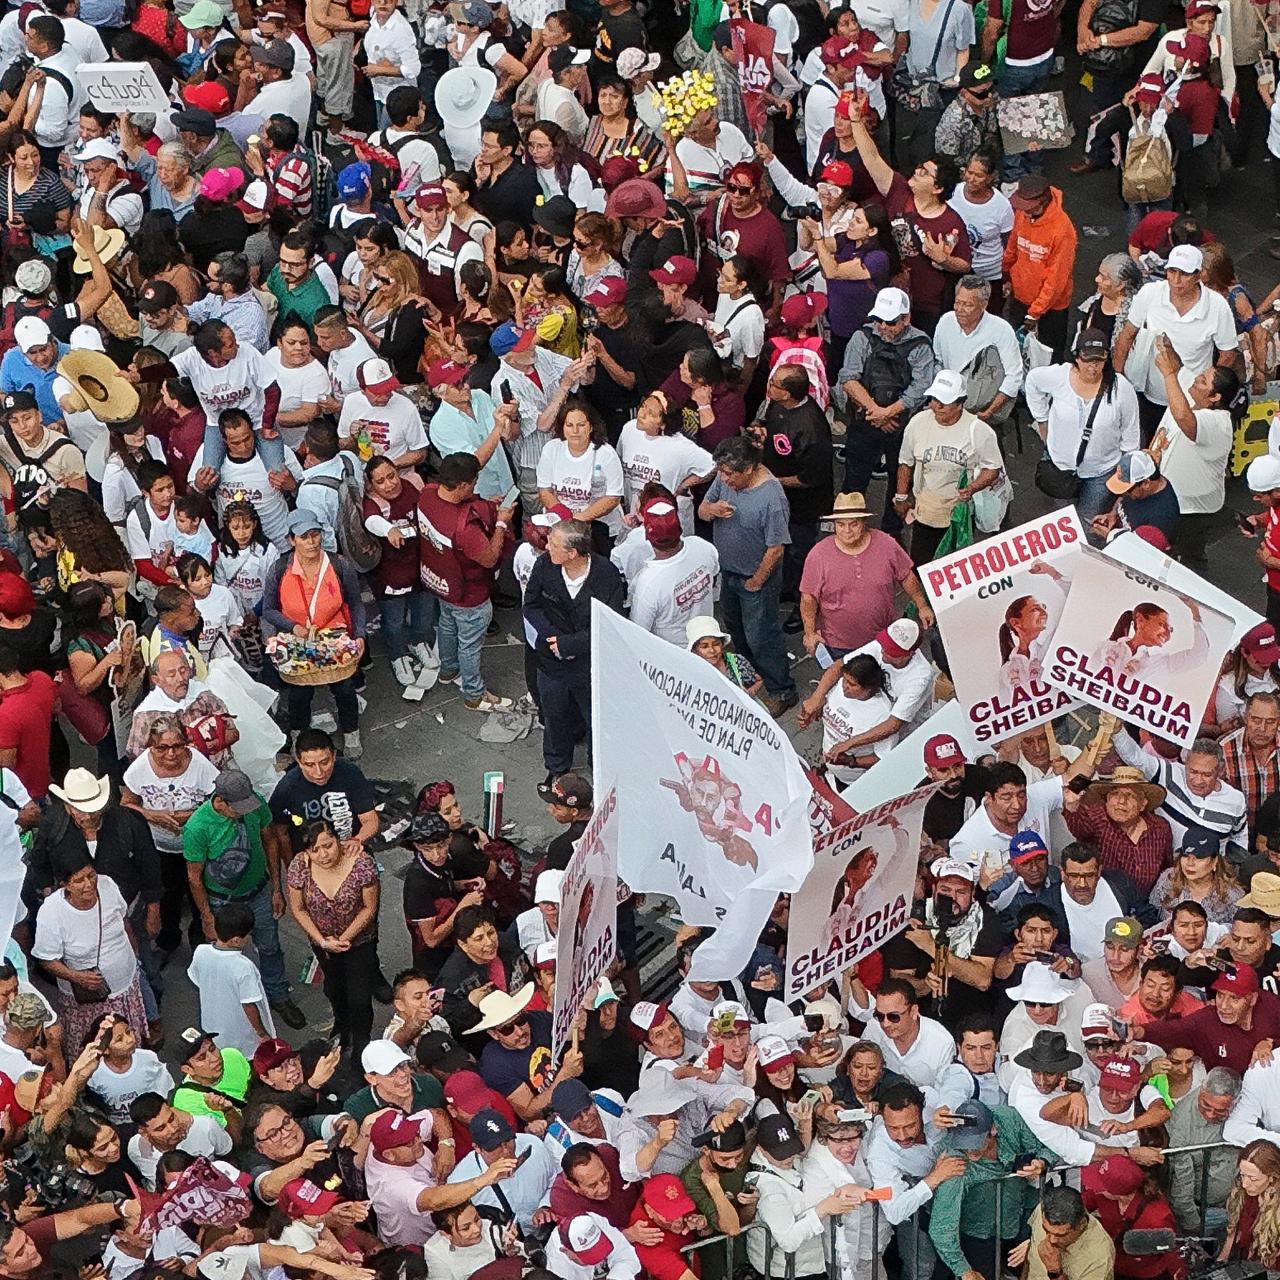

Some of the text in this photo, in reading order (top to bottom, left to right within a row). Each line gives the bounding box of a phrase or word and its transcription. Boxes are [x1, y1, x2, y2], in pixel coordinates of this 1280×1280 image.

[928, 516, 1079, 598] PETROLEROS
[977, 576, 1014, 600] CON
[969, 680, 1053, 724] CLAU
[1050, 668, 1190, 740] SHEIBAUM
[1055, 645, 1193, 725] CLAUDIA
[831, 831, 863, 858] CON
[810, 909, 906, 995] SHEIBAUM
[811, 894, 907, 978] CLAUDIA
